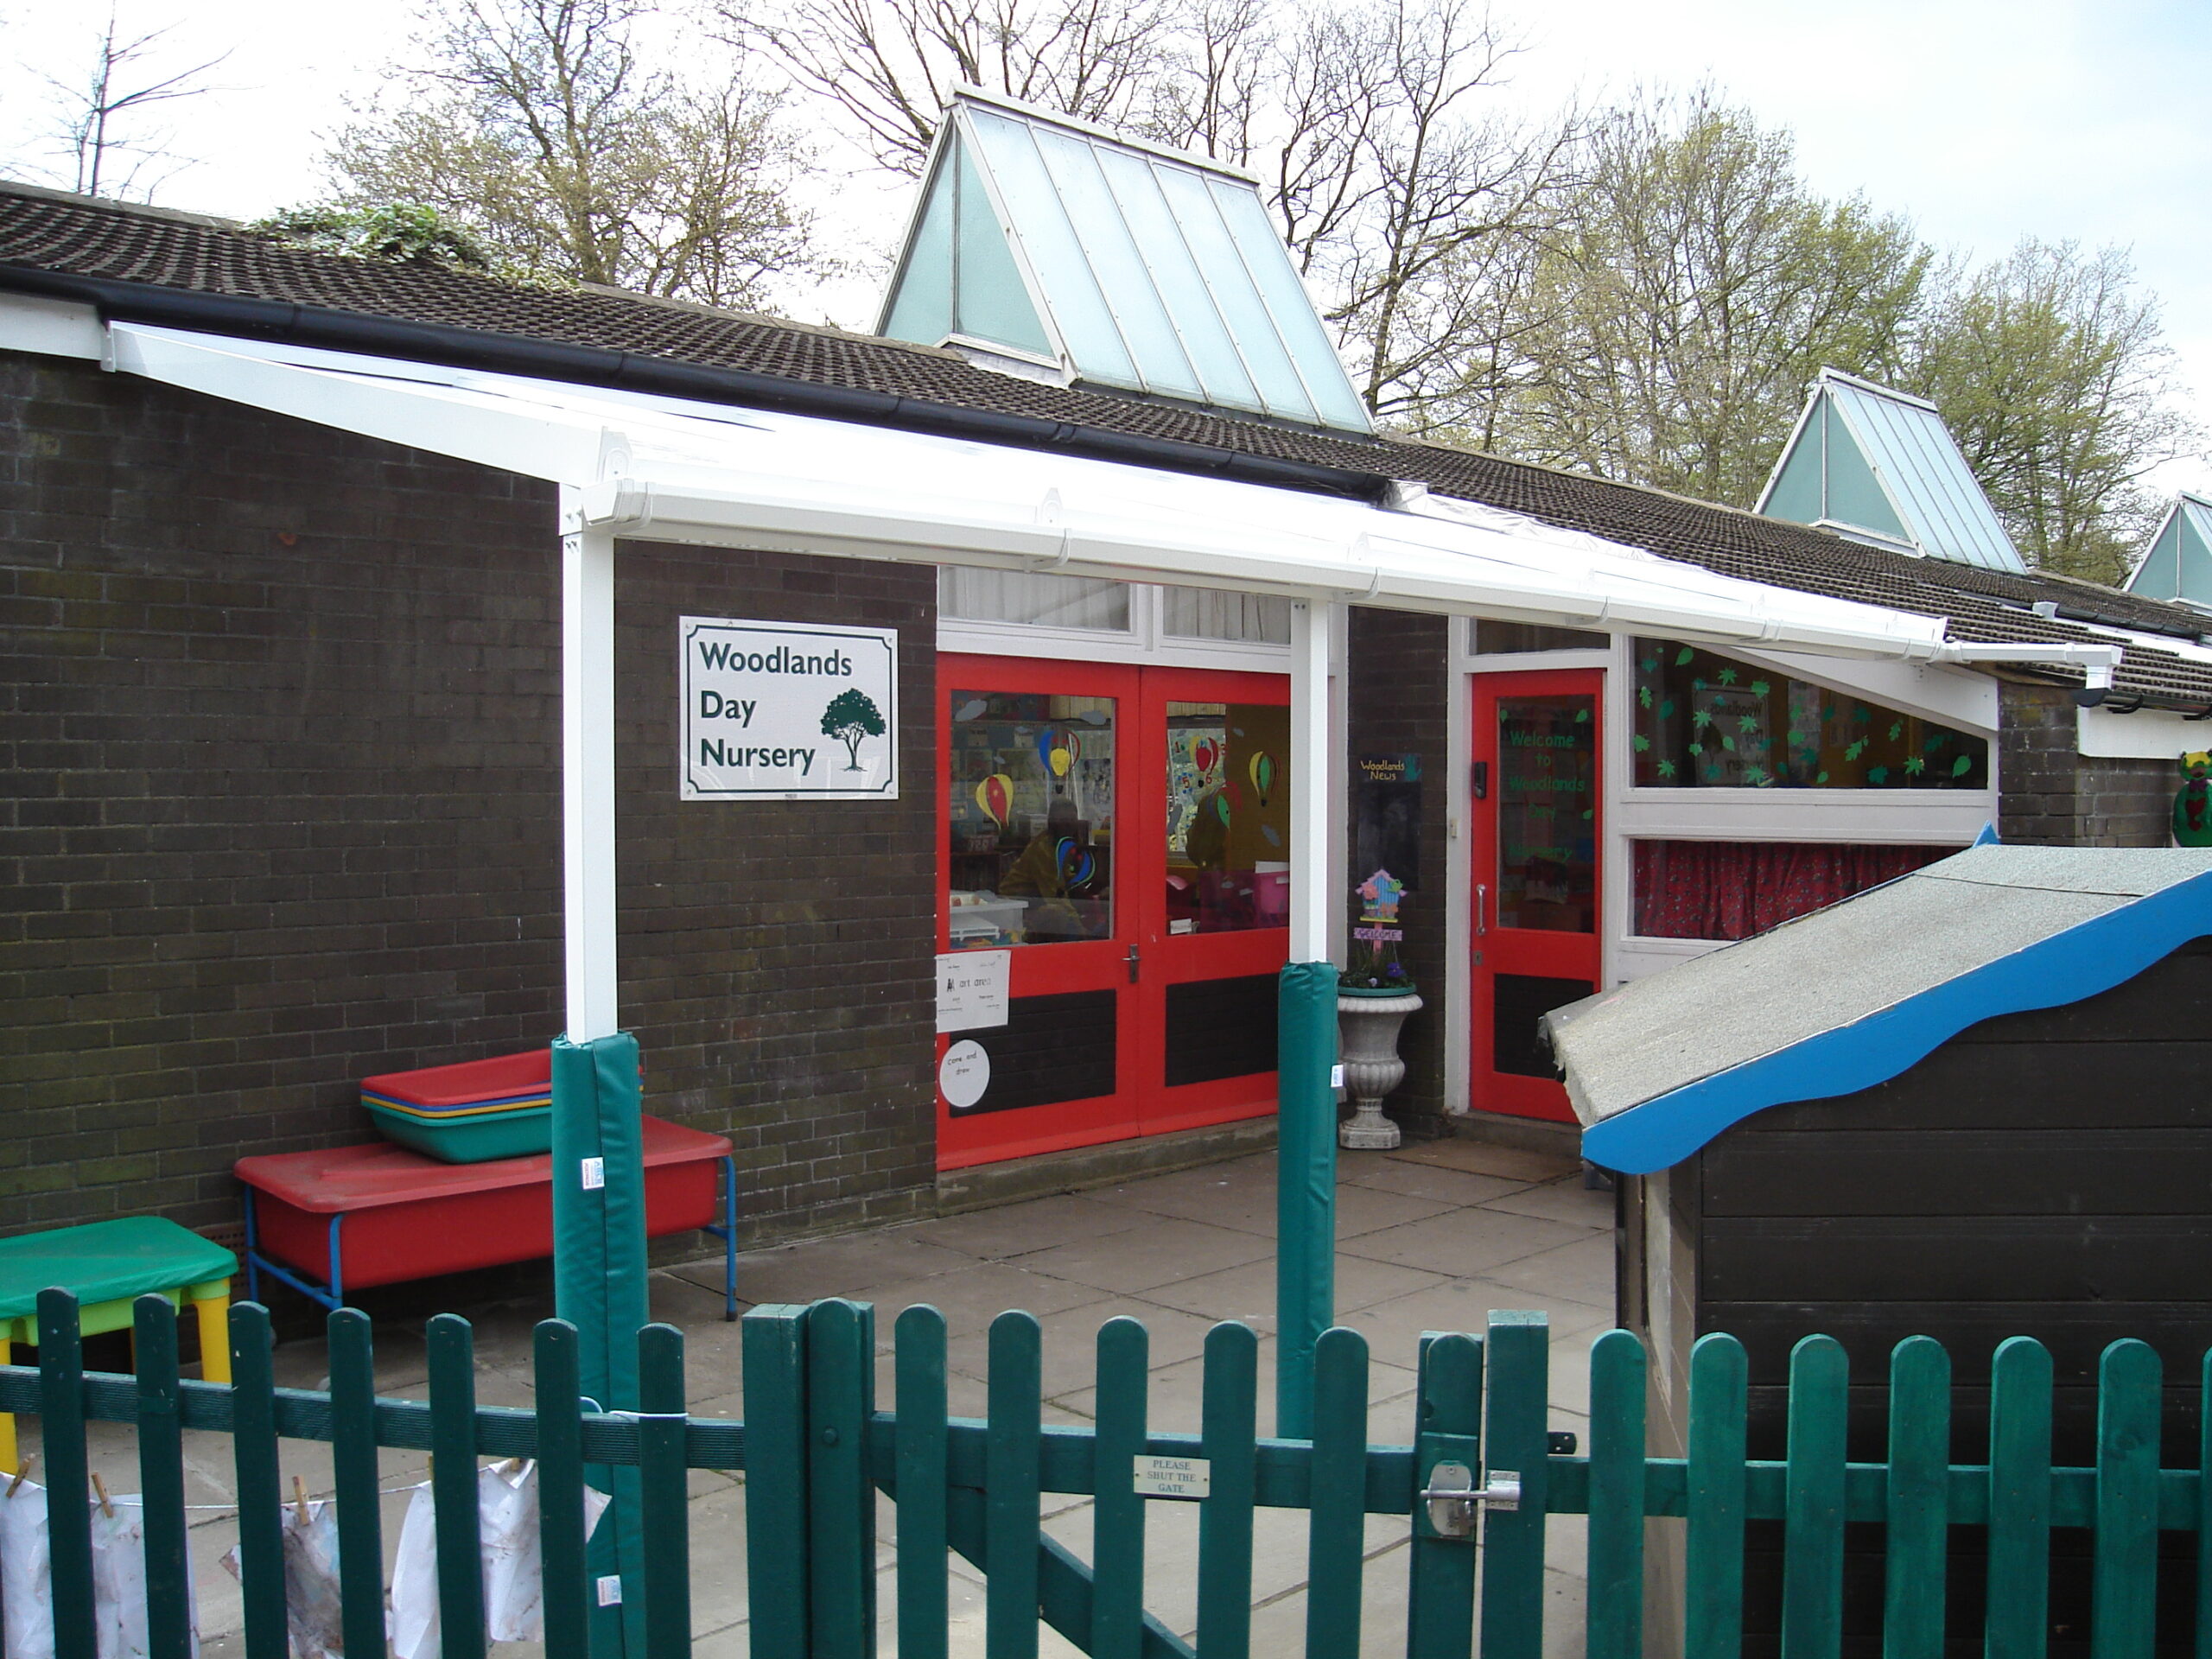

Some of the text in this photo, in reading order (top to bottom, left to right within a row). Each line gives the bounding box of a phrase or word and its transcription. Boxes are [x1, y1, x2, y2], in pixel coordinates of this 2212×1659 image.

[699, 641, 852, 677] Woodlands
[700, 690, 757, 728] Day
[1510, 729, 1576, 747] Welcome
[700, 738, 816, 776] Nursery
[1359, 759, 1405, 771] Woodlands
[1534, 753, 1552, 768] to
[1370, 771, 1396, 780] News
[1509, 775, 1586, 792] Woodlands
[1527, 802, 1556, 823] Day
[1153, 1459, 1192, 1471] PLEASE
[1147, 1471, 1197, 1483] SHUT THE
[1158, 1483, 1185, 1493] GATE
